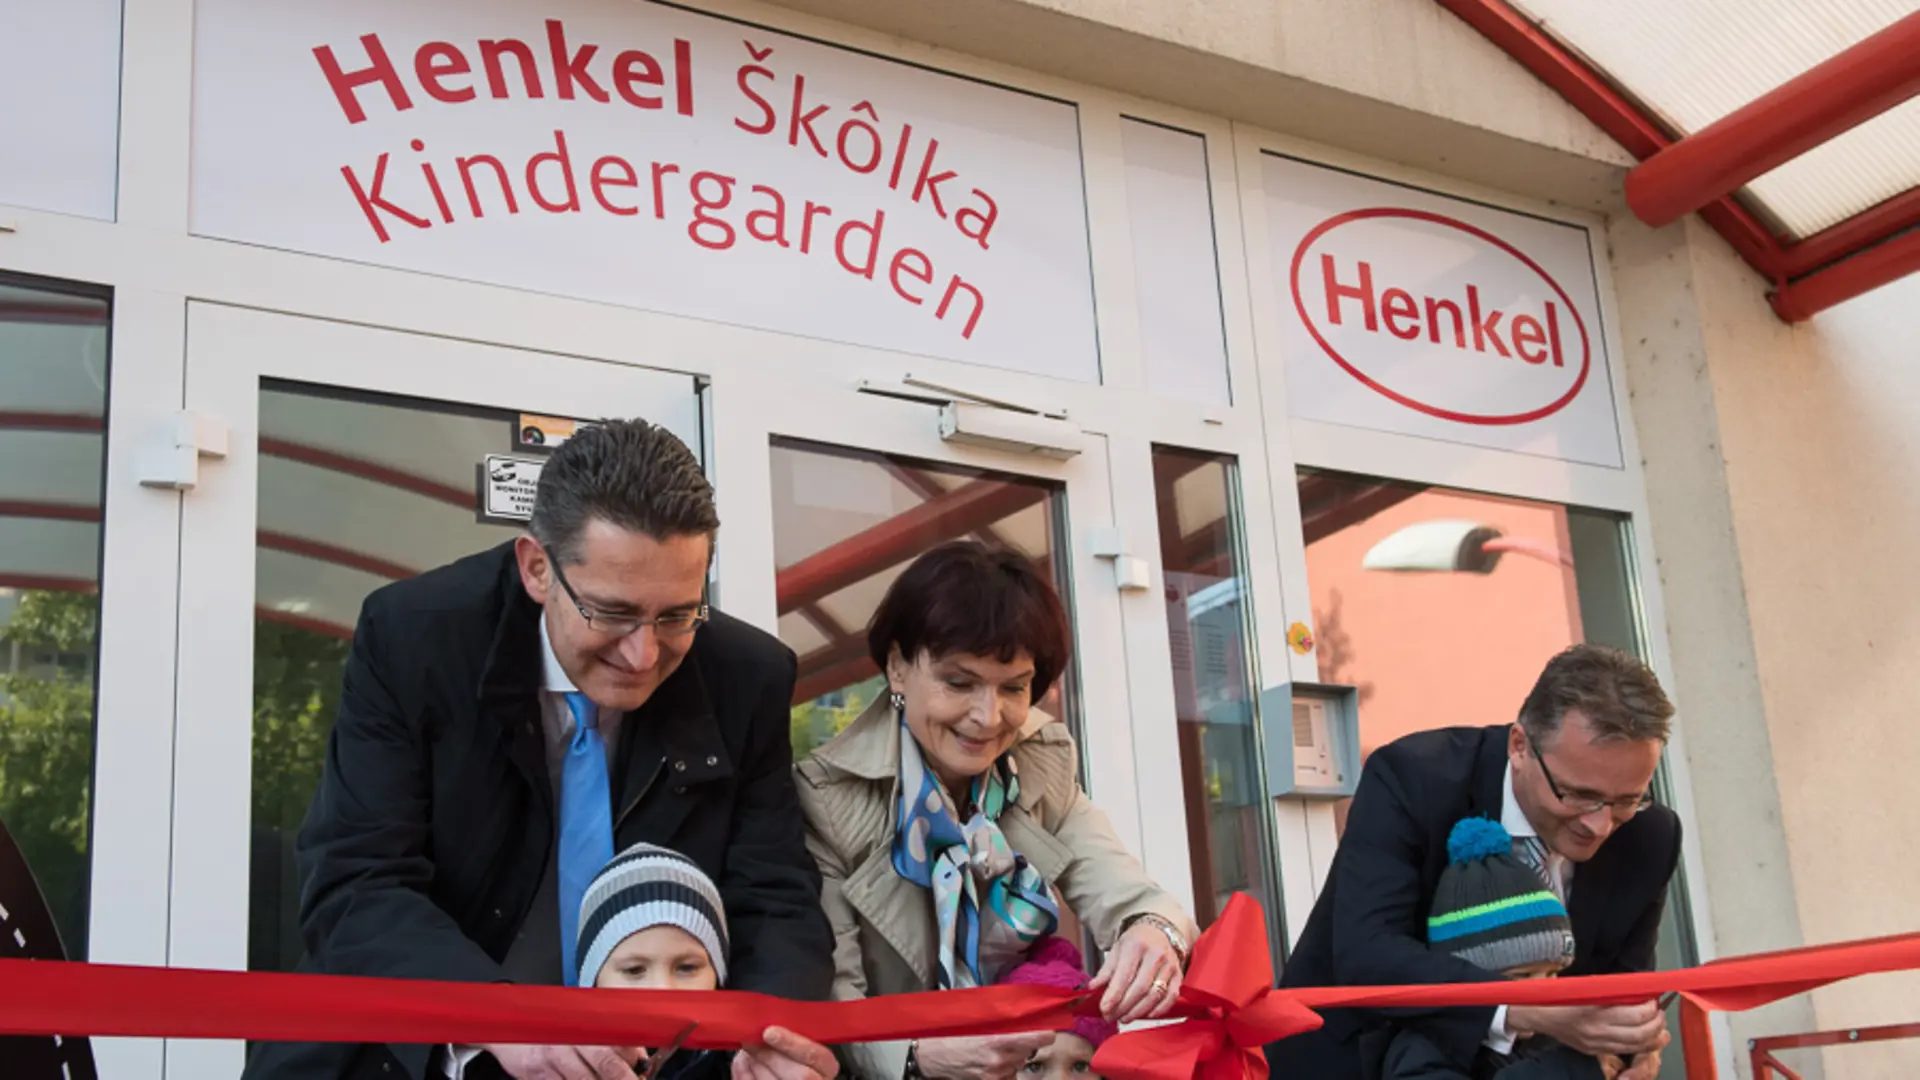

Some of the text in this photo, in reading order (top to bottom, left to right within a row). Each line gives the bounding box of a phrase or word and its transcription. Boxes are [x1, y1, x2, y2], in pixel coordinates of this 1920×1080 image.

[312, 18, 999, 251] Henkel Škôlka
[340, 129, 985, 340] Kindergarden
[1320, 253, 1565, 368] Henkel
